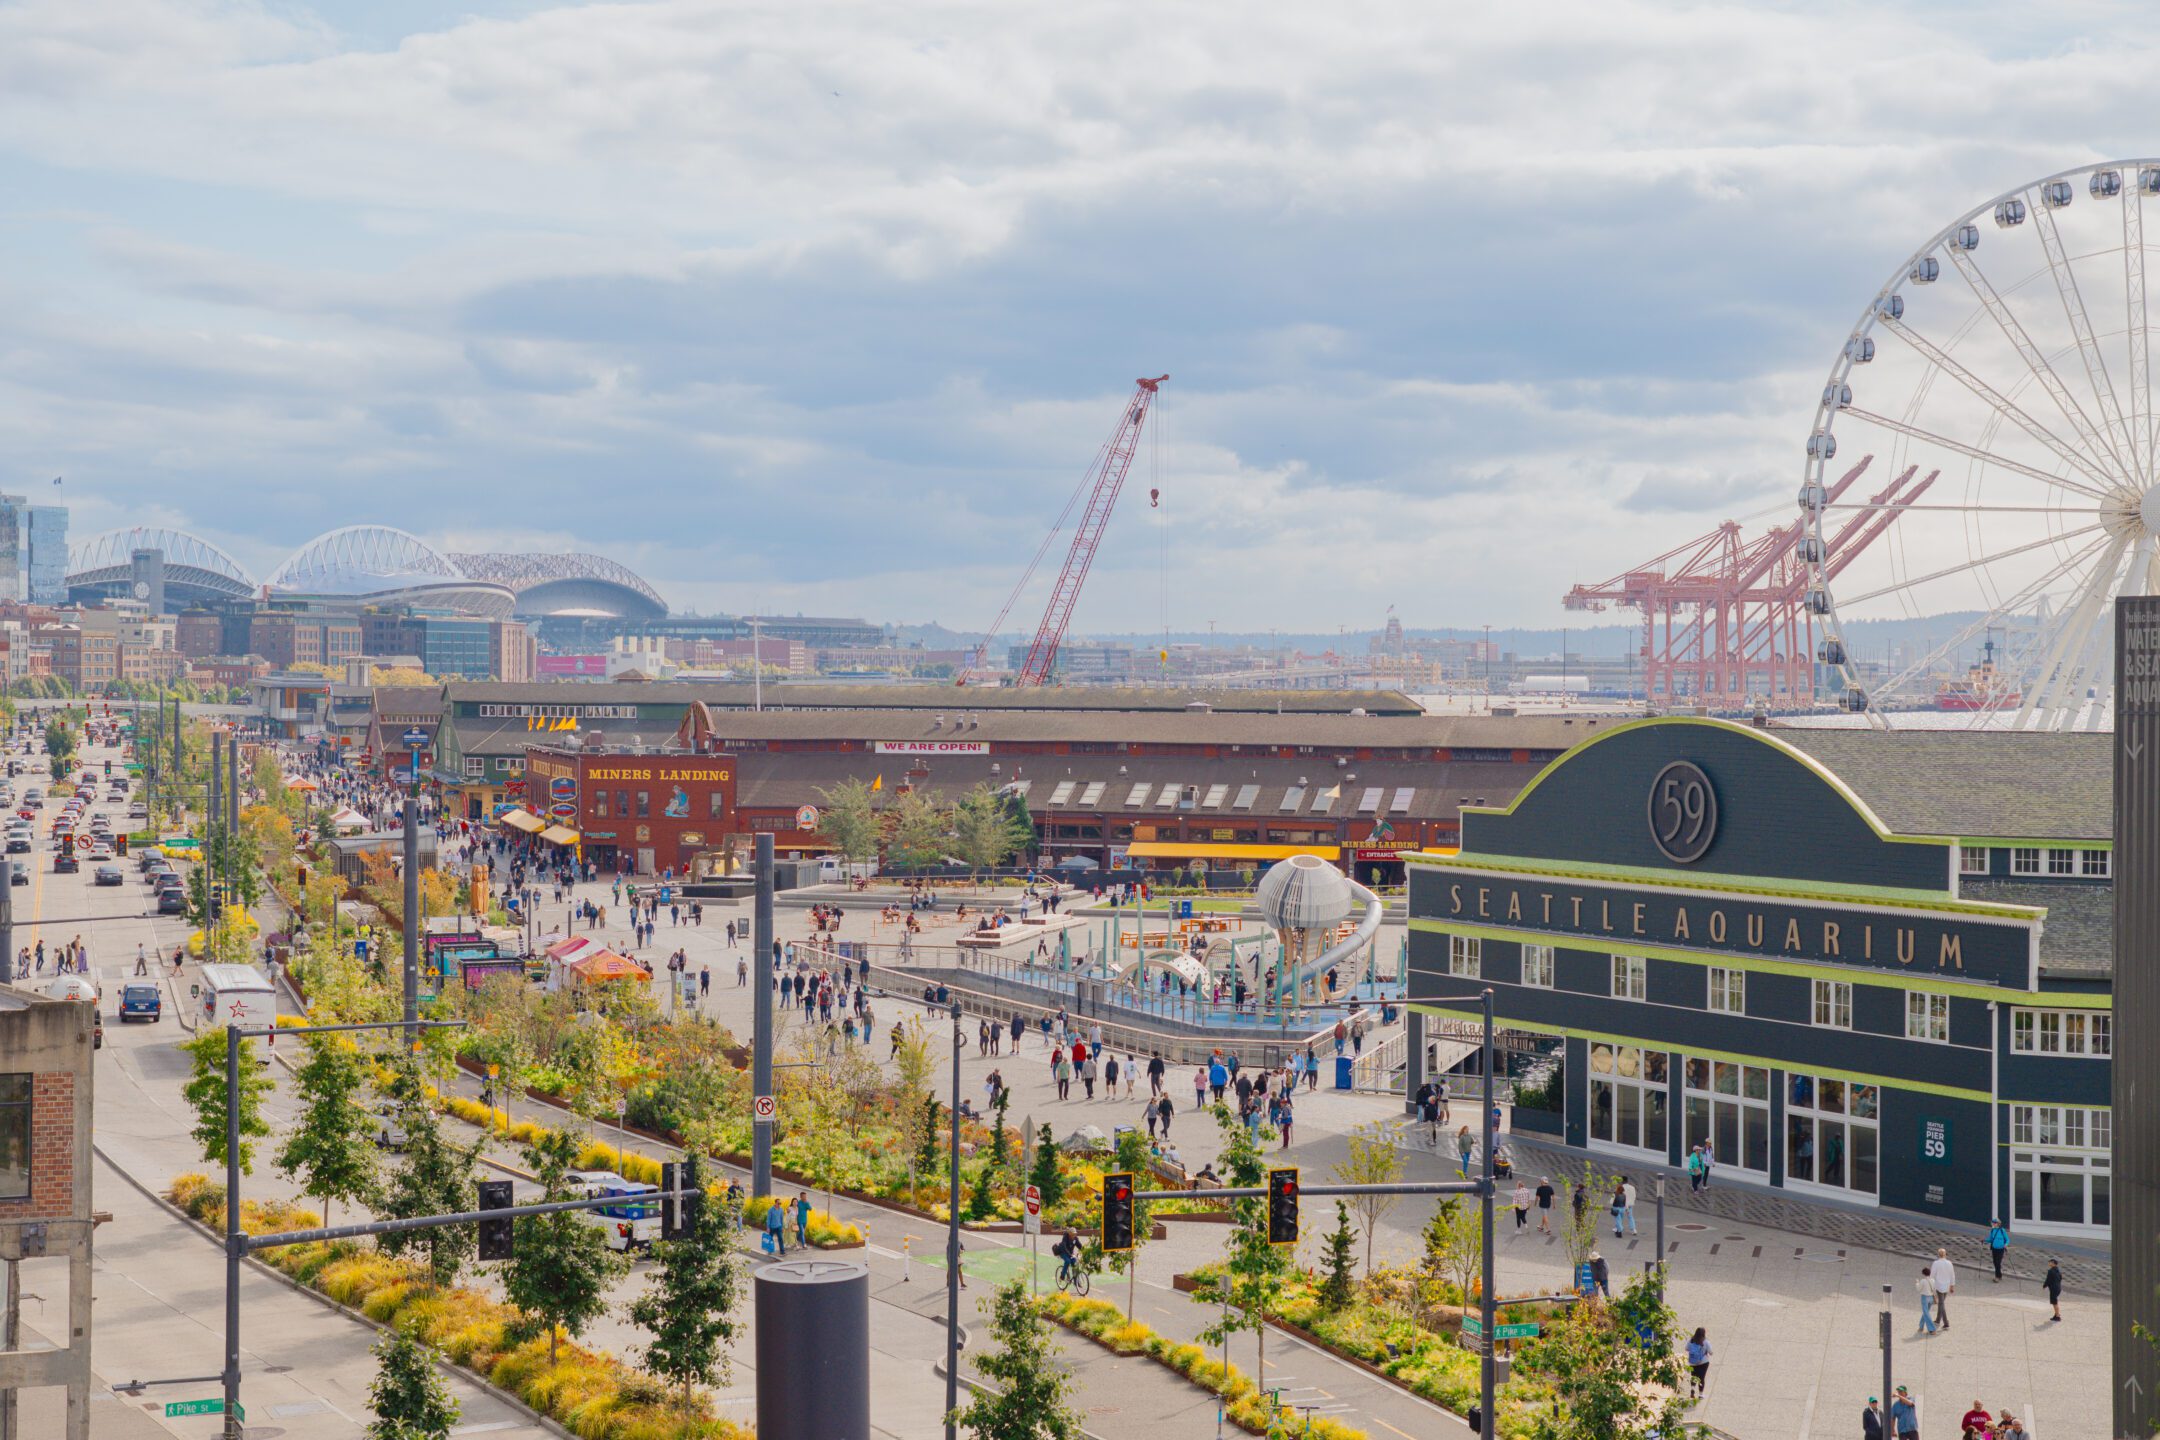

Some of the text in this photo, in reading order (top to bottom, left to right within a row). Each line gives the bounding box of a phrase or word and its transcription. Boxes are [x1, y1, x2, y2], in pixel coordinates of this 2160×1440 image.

[2125, 611, 2146, 622] Public
[2125, 628, 2160, 649] WATE
[2125, 654, 2160, 676] & SEA
[2125, 681, 2160, 705] AQUA
[938, 743, 982, 751] OPEN!
[588, 769, 729, 781] MINERS LANDING
[1664, 780, 1705, 844] 59
[1378, 841, 1419, 849] LANDING
[1450, 884, 1963, 969] SEATTLE AQUARIUM
[1926, 1131, 1944, 1140] PIER
[1925, 1140, 1945, 1158] 59
[1502, 1327, 1518, 1337] Pike
[176, 1403, 209, 1415] Pike St
